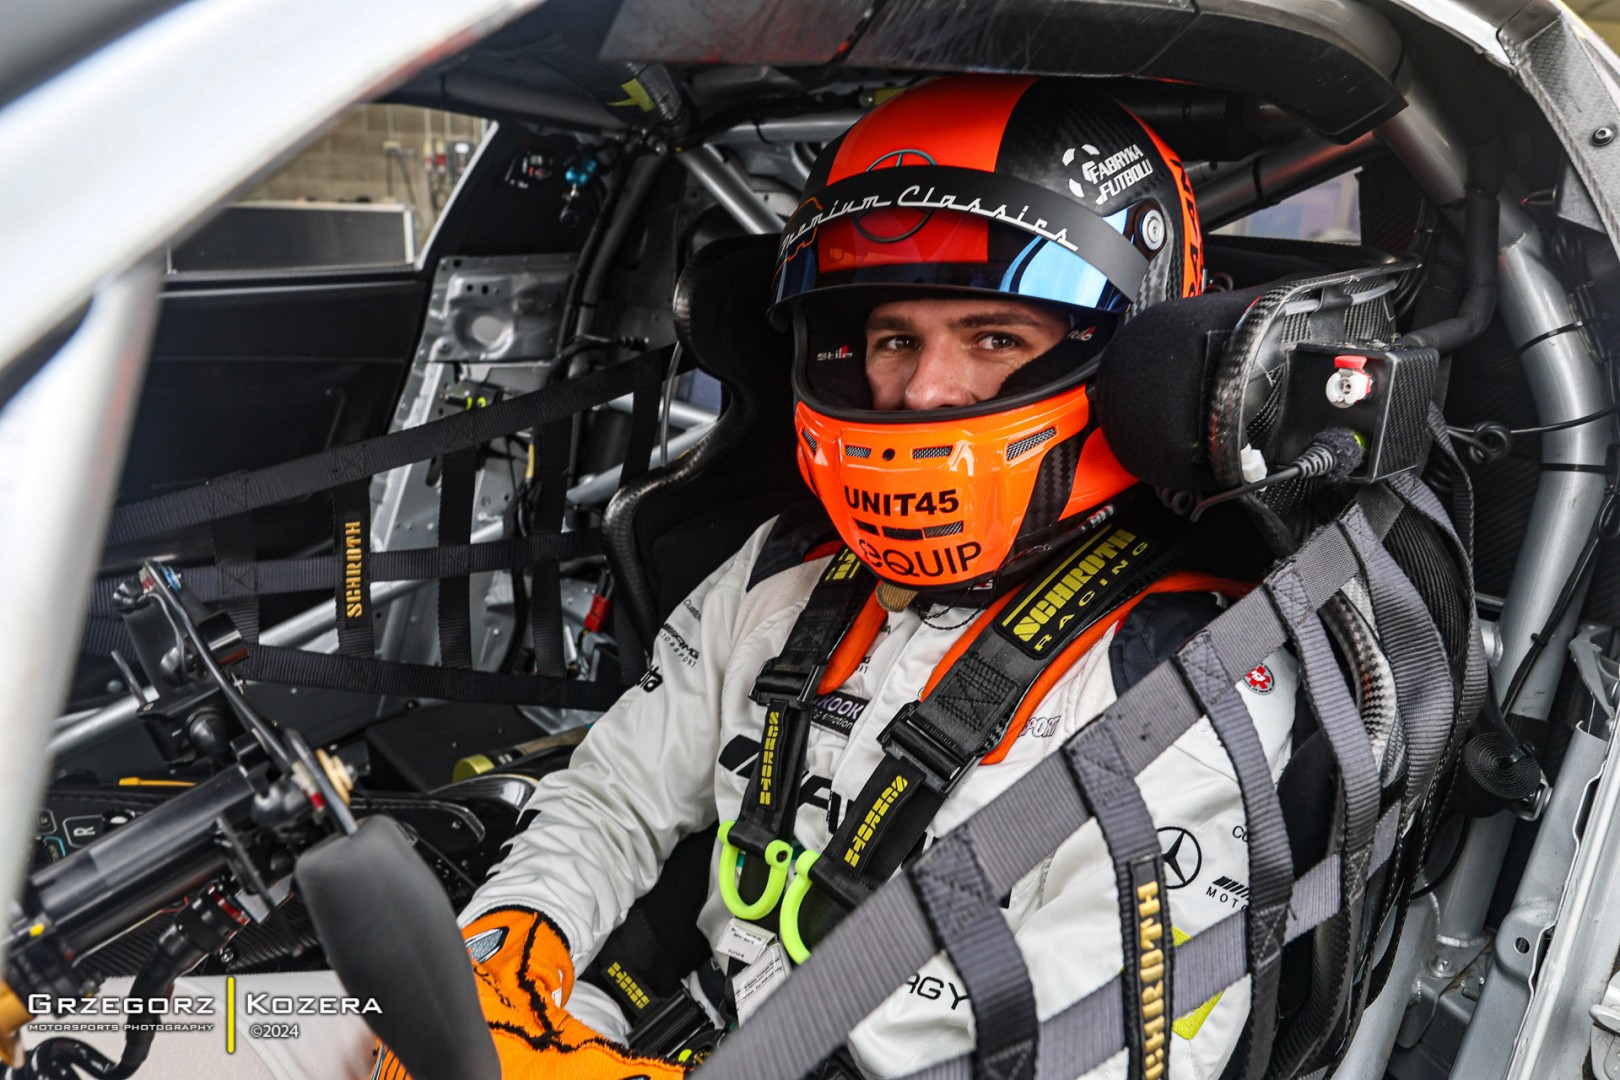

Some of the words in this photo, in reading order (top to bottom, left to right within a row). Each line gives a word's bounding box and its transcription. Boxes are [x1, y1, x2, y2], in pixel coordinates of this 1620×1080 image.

[1087, 143, 1144, 185] FABRYKA
[1095, 158, 1154, 205] FUTBOLU
[780, 195, 892, 256] Premium
[897, 185, 1079, 251] Classics
[844, 485, 960, 517] UNIT45
[344, 521, 363, 618] SCHROTH
[1012, 528, 1137, 643] SCHROTH
[1033, 541, 1149, 652] RACING
[817, 695, 865, 720] KOOK
[759, 711, 780, 806] SCHROTH
[843, 774, 909, 868] SCHROTH
[1136, 880, 1167, 1080] CHROTH
